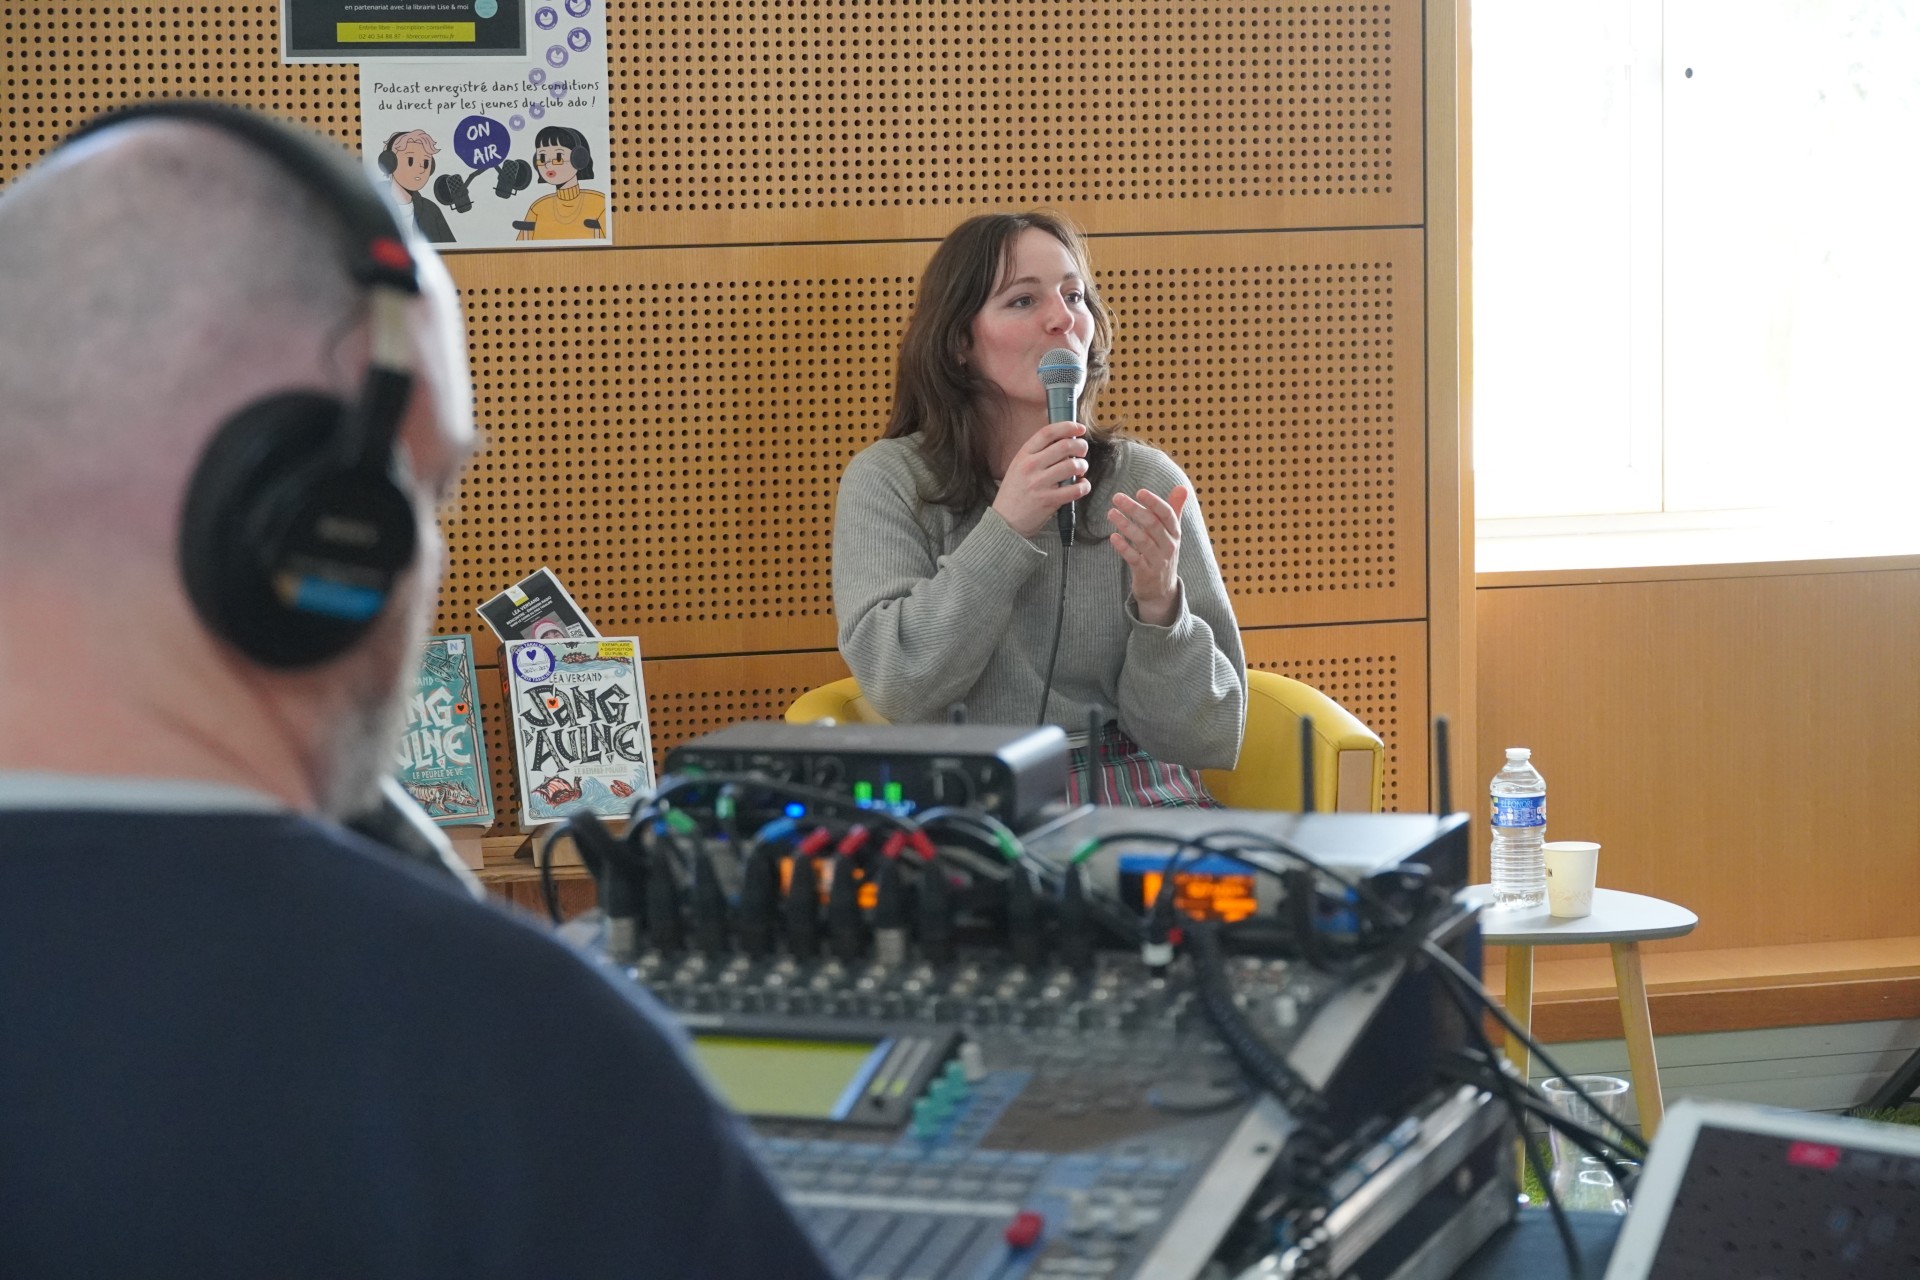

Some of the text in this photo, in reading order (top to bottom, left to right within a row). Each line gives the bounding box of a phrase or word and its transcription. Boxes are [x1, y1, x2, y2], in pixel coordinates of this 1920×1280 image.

[374, 79, 599, 97] Podcast enregistré dans les conditions
[379, 96, 596, 115] du direct par les jeunes du club ado !
[466, 121, 490, 141] ON
[473, 144, 502, 164] AIR
[549, 672, 602, 683] LÉA VERSAND
[406, 686, 454, 729] NG
[422, 769, 445, 779] PEUPLE
